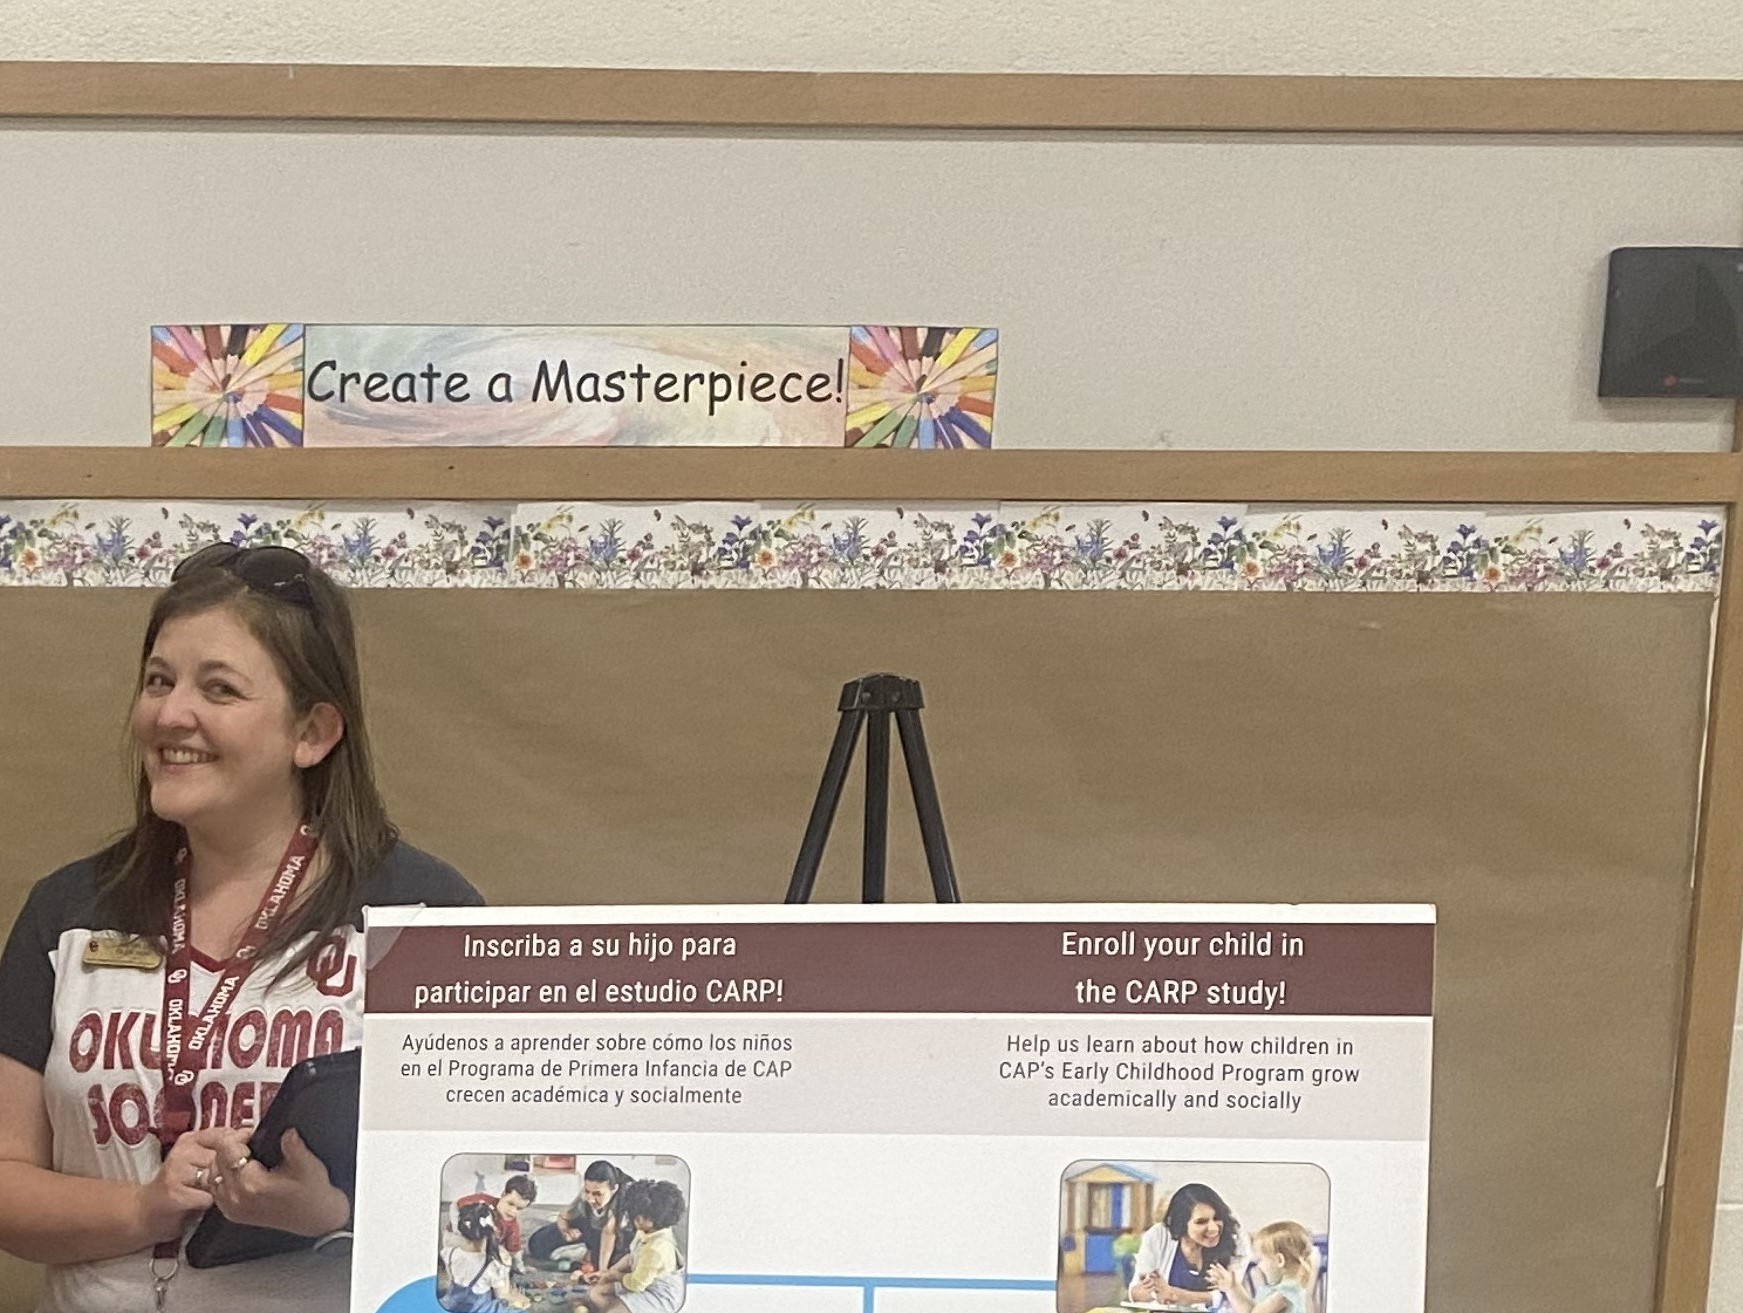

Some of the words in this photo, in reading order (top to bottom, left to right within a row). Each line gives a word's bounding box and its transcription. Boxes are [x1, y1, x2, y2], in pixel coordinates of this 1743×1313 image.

[307, 359, 471, 404] Create
[487, 372, 513, 403] a
[531, 357, 844, 417] Masterpiece!
[255, 855, 306, 931] OKLAHOMA
[464, 932, 561, 958] Inscriba
[569, 938, 583, 957] a
[591, 938, 620, 957] su
[628, 931, 673, 962] hijo
[681, 937, 736, 962] para
[1062, 930, 1135, 956] Enroll
[1143, 937, 1202, 962] your
[1209, 930, 1272, 957] child
[1281, 932, 1304, 957] in
[414, 979, 532, 1009] participar
[539, 984, 567, 1003] en
[575, 978, 597, 1003] el
[605, 978, 697, 1003] estudio
[706, 978, 783, 1003] CARP!
[1075, 978, 1117, 1004] the
[1125, 979, 1198, 1005] CARP
[1206, 979, 1286, 1011] study!
[187, 974, 240, 1051] OKLAHOMA
[402, 1033, 488, 1056] Ayúdenos
[494, 1037, 504, 1051] a
[510, 1033, 590, 1055] aprender
[595, 1032, 647, 1051] sobre
[652, 1033, 703, 1051] cómo
[709, 1033, 736, 1051] los
[742, 1033, 793, 1052] niños
[1007, 1034, 1051, 1057] Help
[1057, 1039, 1079, 1053] us
[1086, 1034, 1135, 1053] learn
[1141, 1035, 1197, 1054] about
[1204, 1035, 1244, 1054] how
[1250, 1035, 1329, 1055] children
[1337, 1036, 1353, 1055] in
[400, 1063, 421, 1077] en
[427, 1058, 442, 1077] el
[448, 1059, 535, 1081] Programa
[540, 1058, 562, 1077] de
[568, 1059, 638, 1077] Primera
[645, 1058, 718, 1077] Infancia
[724, 1059, 747, 1077] de
[753, 1059, 792, 1078] CAP
[999, 1060, 1055, 1080] CAP's
[1062, 1061, 1109, 1084] Early
[1116, 1061, 1214, 1081] Childhood
[1222, 1063, 1304, 1086] Program
[1312, 1068, 1360, 1087] grow
[446, 1089, 505, 1103] crecen
[511, 1085, 609, 1103] académica
[614, 1089, 625, 1108] y
[629, 1085, 742, 1104] socialmente
[1048, 1088, 1177, 1113] academically
[1183, 1089, 1219, 1108] and
[1226, 1090, 1302, 1114] socially
